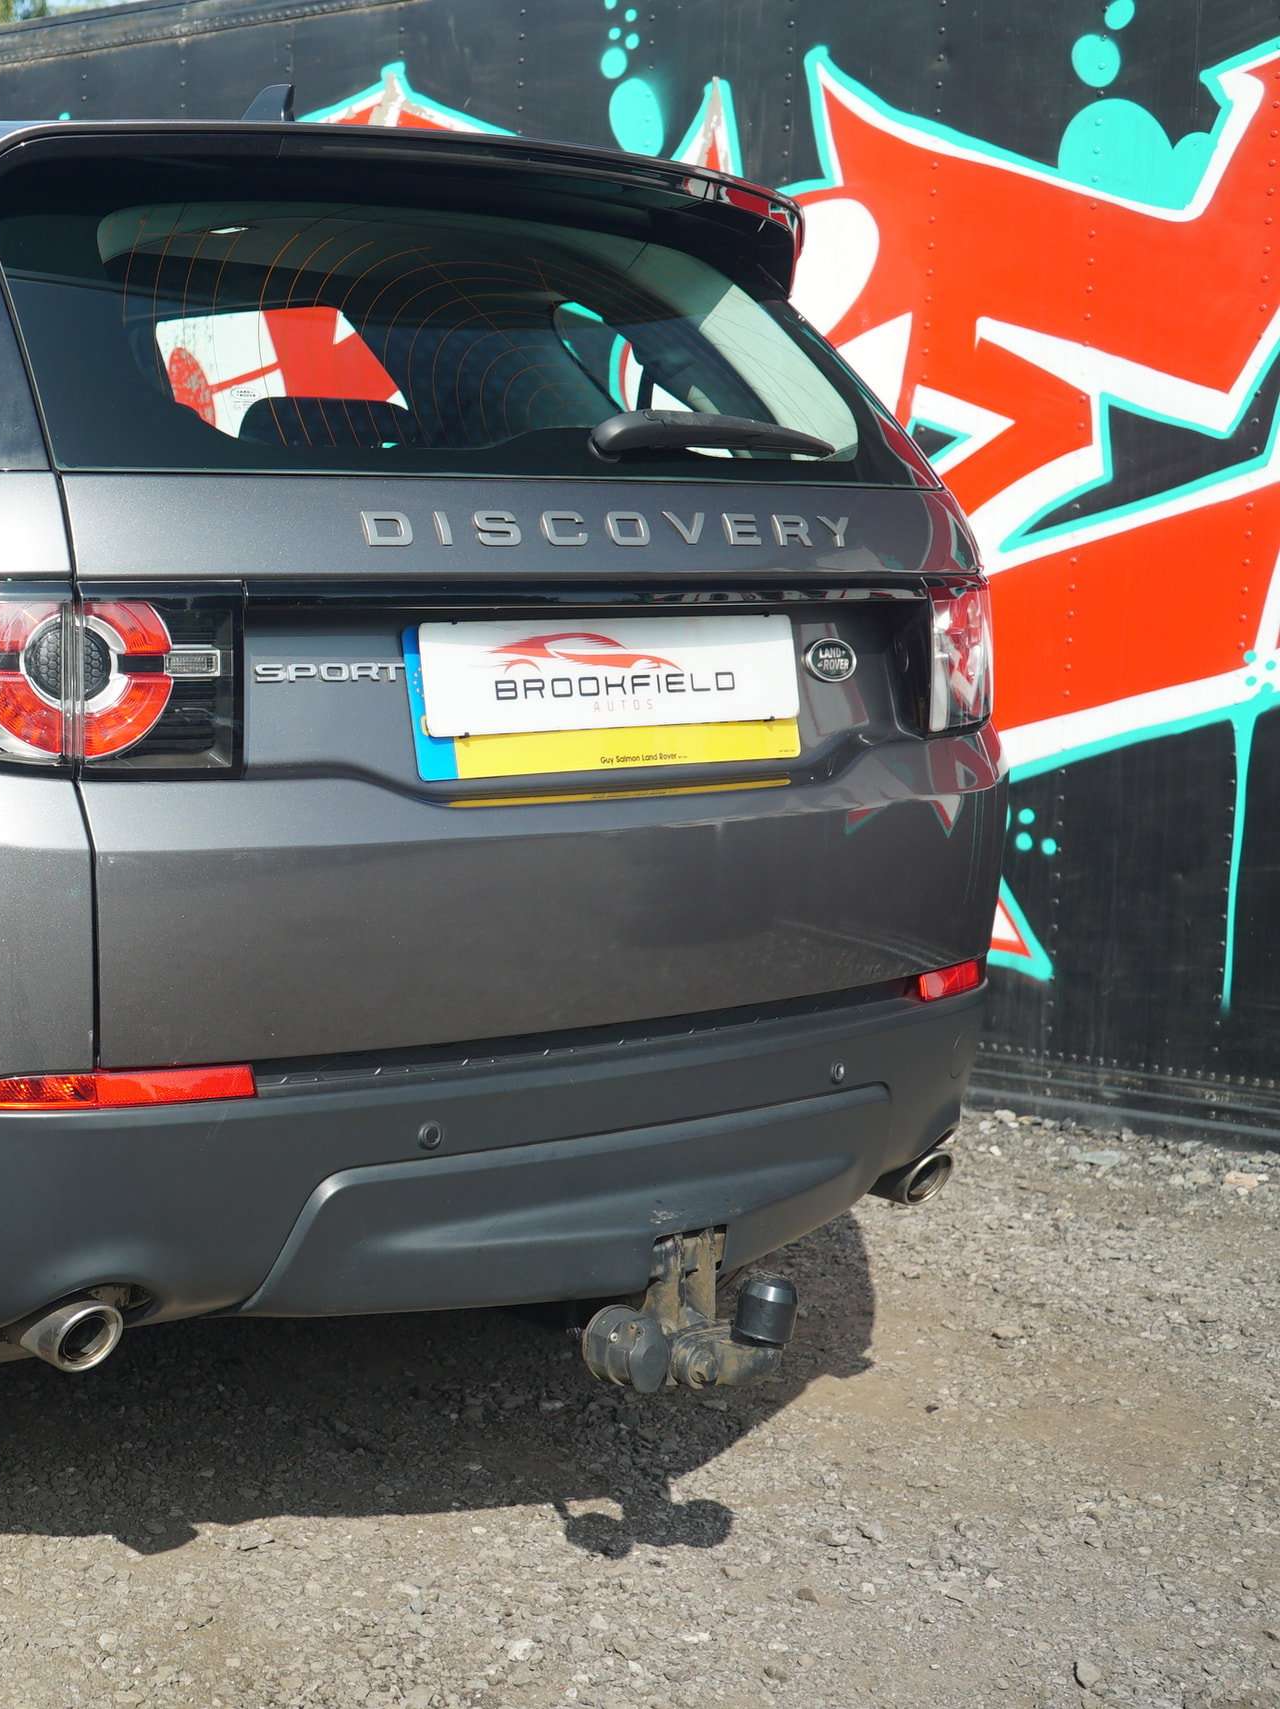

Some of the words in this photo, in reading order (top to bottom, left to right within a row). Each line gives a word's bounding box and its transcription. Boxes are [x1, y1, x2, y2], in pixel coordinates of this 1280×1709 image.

[360, 510, 849, 547] DISCOVERY
[819, 647, 841, 658] LAND
[823, 658, 849, 670] ROVER
[255, 662, 405, 682] SPORT
[494, 672, 735, 700] BROOKFIELD
[593, 698, 654, 712] AUTOS
[600, 756, 614, 765] Guy
[616, 754, 640, 763] Salmon
[642, 753, 658, 761] Land
[659, 752, 677, 760] Rover
